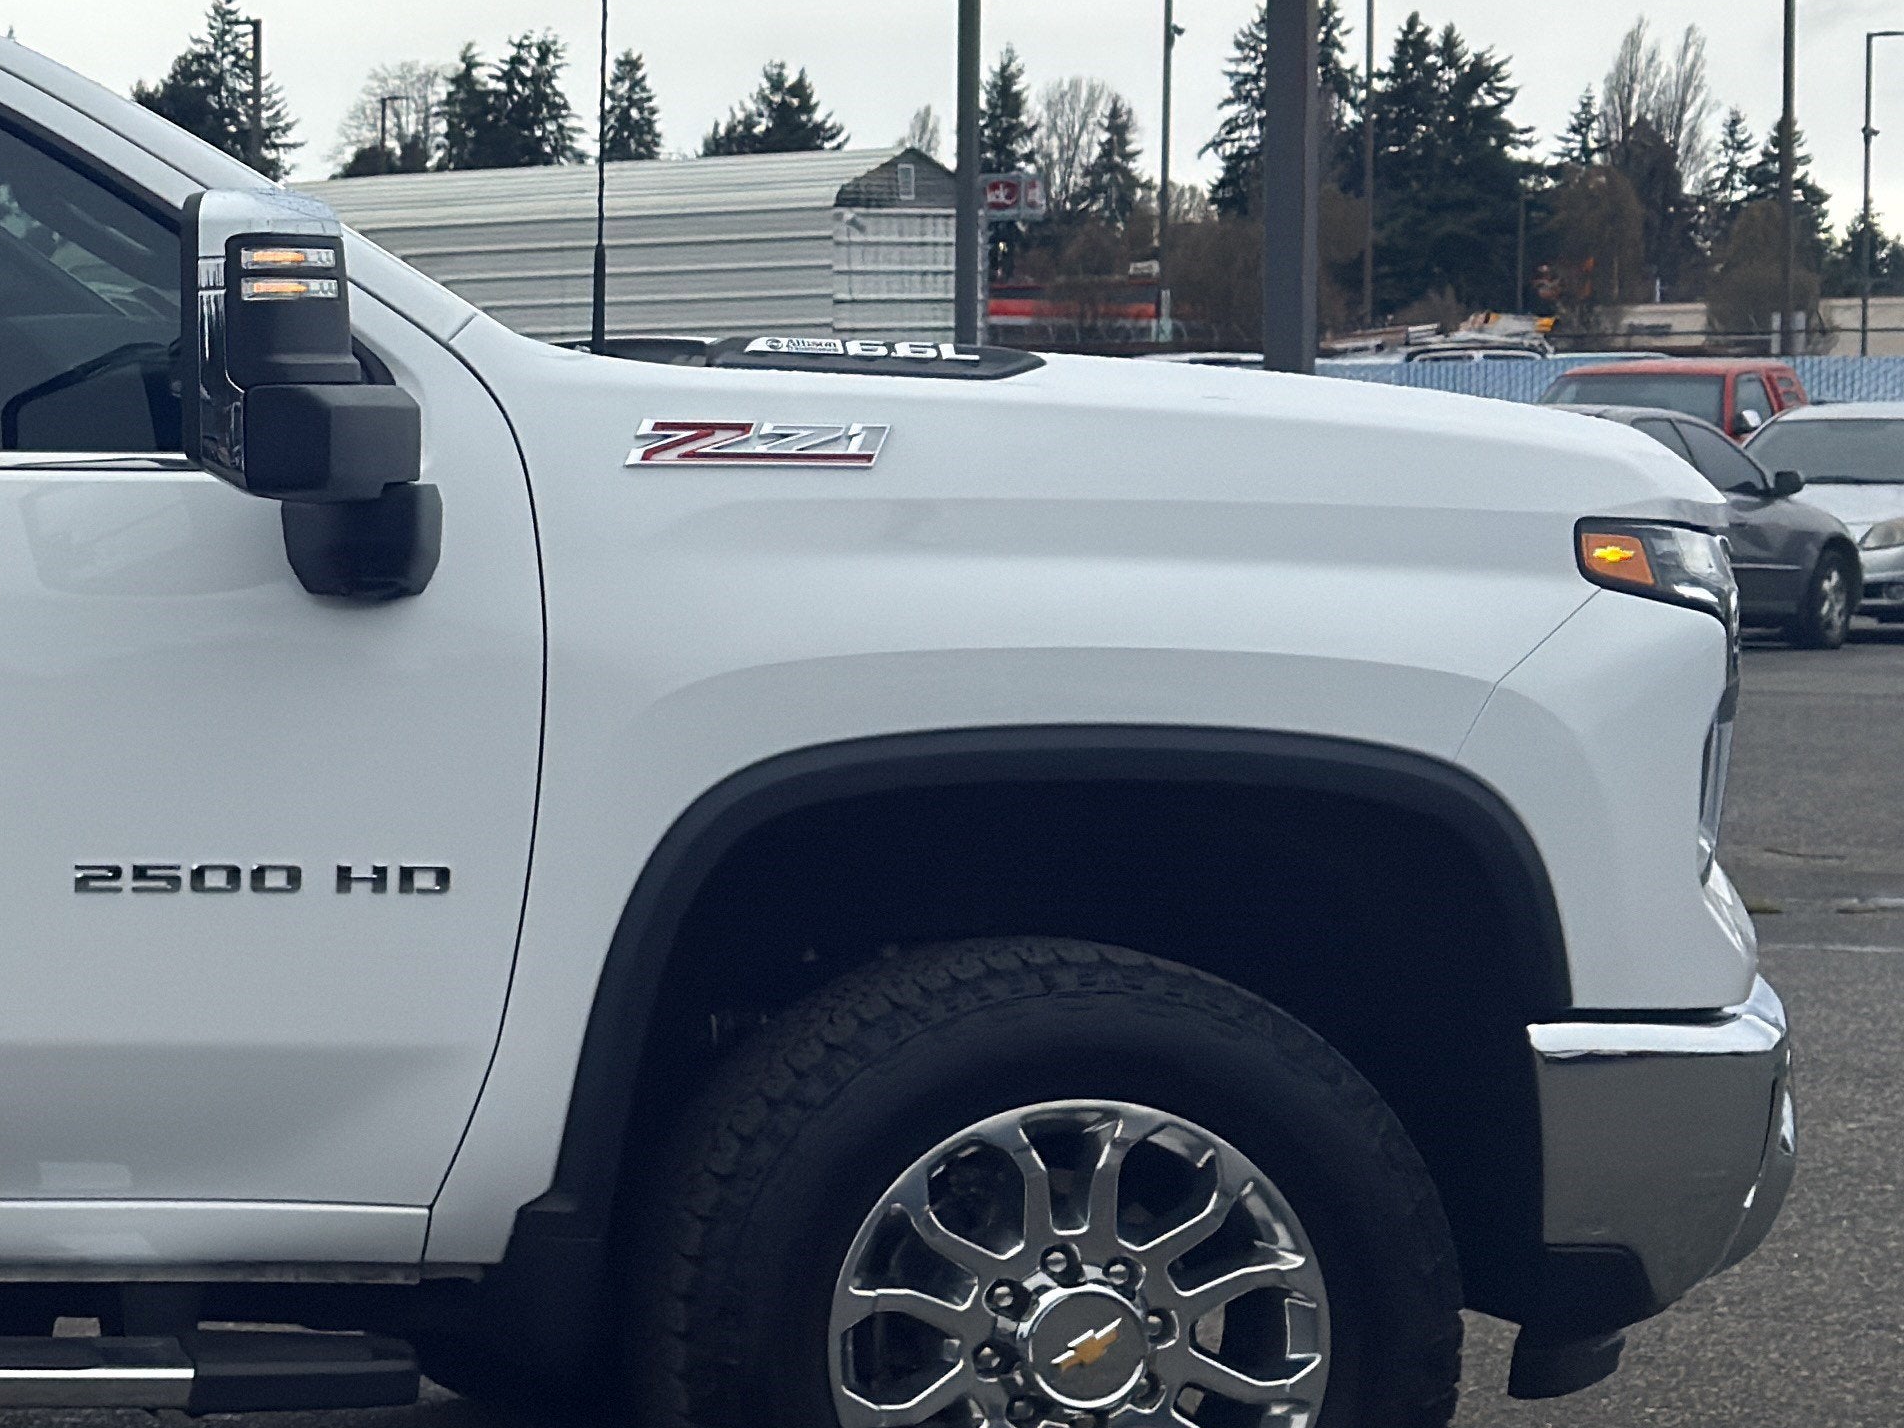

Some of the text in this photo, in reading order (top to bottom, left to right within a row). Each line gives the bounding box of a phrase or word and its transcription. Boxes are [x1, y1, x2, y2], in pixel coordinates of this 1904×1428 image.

[845, 340, 980, 361] 6.6L
[624, 418, 892, 469] Z71
[74, 864, 451, 894] 2500 HD
